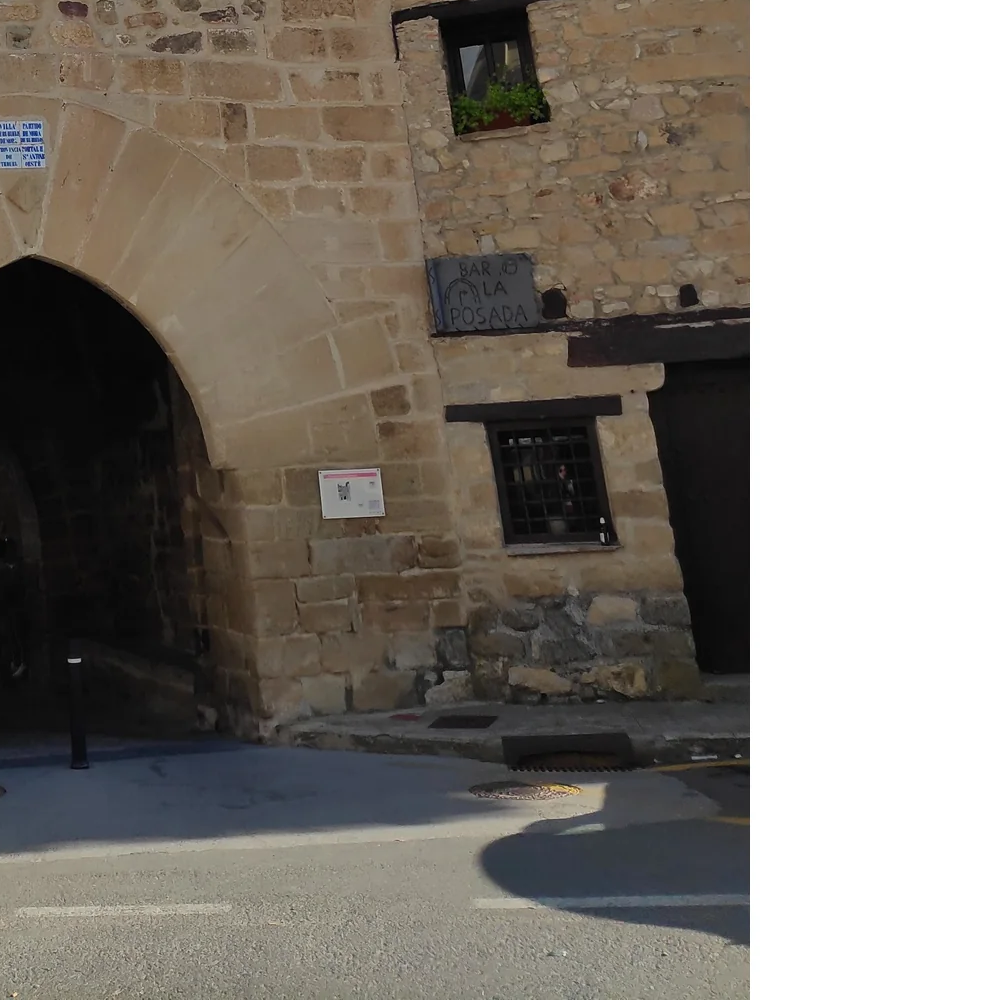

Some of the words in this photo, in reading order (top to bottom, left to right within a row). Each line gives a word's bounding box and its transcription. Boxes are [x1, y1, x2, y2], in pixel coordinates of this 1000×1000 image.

[459, 261, 491, 278] BAR
[482, 280, 508, 296] LA
[450, 304, 528, 326] POSADA
